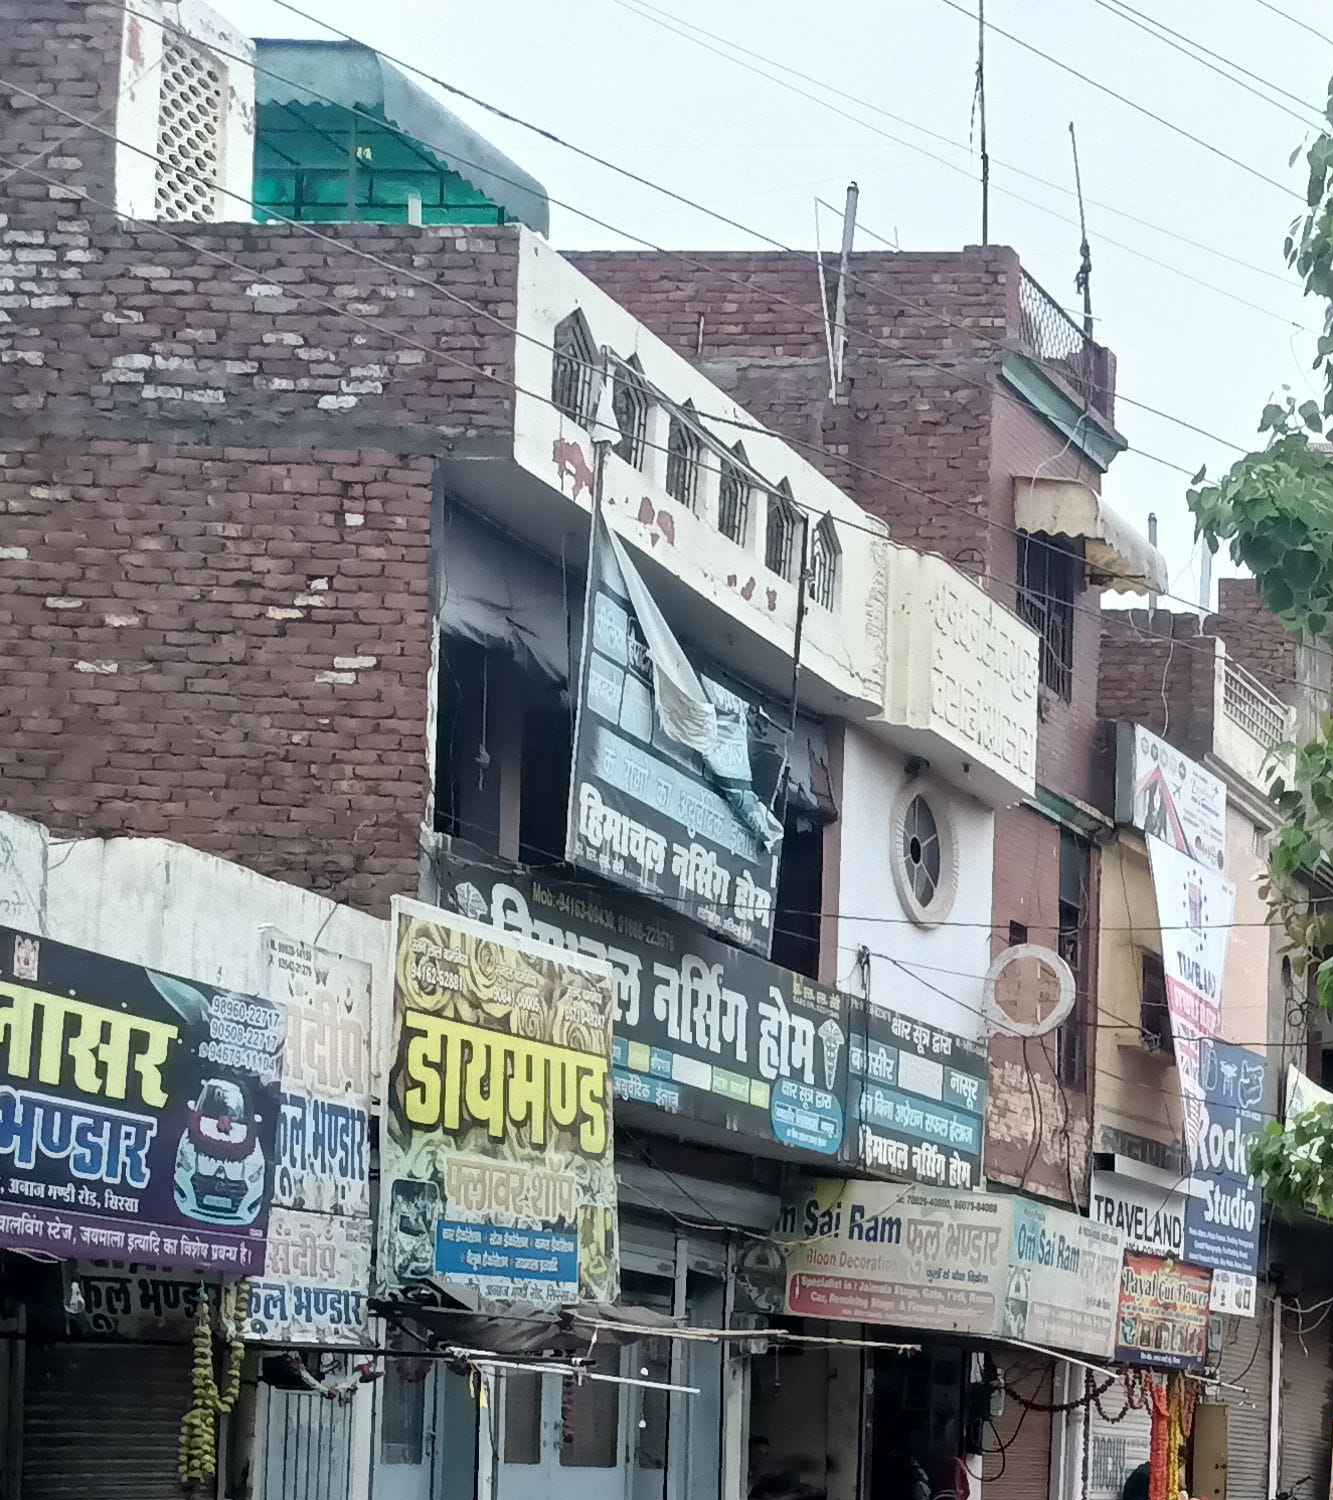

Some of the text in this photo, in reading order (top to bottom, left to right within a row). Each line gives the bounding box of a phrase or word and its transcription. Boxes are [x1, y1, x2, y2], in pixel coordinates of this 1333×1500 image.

[579, 782, 667, 874] हिमाचल
[671, 842, 730, 905] नर्सिंग
[733, 868, 772, 928] होम
[213, 996, 280, 1028] 98960-22717
[653, 953, 749, 1064] नर्सिंग
[758, 984, 816, 1086] होम
[210, 1021, 278, 1052] 90508-22717
[892, 1016, 911, 1041] क्षार
[912, 1023, 931, 1055] सूत्र
[406, 1010, 608, 1153] डायमण्ड
[950, 1070, 979, 1109] नासूर
[0, 1085, 158, 1190] भण्डार
[312, 1098, 366, 1182] भण्डार
[1199, 1107, 1257, 1190] Rock
[531, 1153, 575, 1218] शॉप
[948, 1150, 972, 1189] होम
[8, 1178, 46, 1199] अनाज
[47, 1182, 77, 1204] मण्डी
[104, 1188, 140, 1213] सिरसा
[1203, 1179, 1256, 1232] Studio
[79, 1225, 125, 1250] जयमाला
[127, 1230, 161, 1256] इत्यादि
[162, 1238, 179, 1256] का
[180, 1234, 209, 1260] विशेष
[803, 1199, 843, 1239] Sai
[848, 1204, 903, 1245] Ram
[944, 1221, 1002, 1268] भण्डार
[1094, 1194, 1182, 1249] TRAVELAND
[806, 1247, 899, 1273] Bloon Decoration
[1017, 1223, 1036, 1262] Om
[1036, 1228, 1057, 1267] Sai
[1056, 1235, 1080, 1274] Ram
[293, 1285, 362, 1327] भण्डार
[1123, 1267, 1158, 1302] Payal
